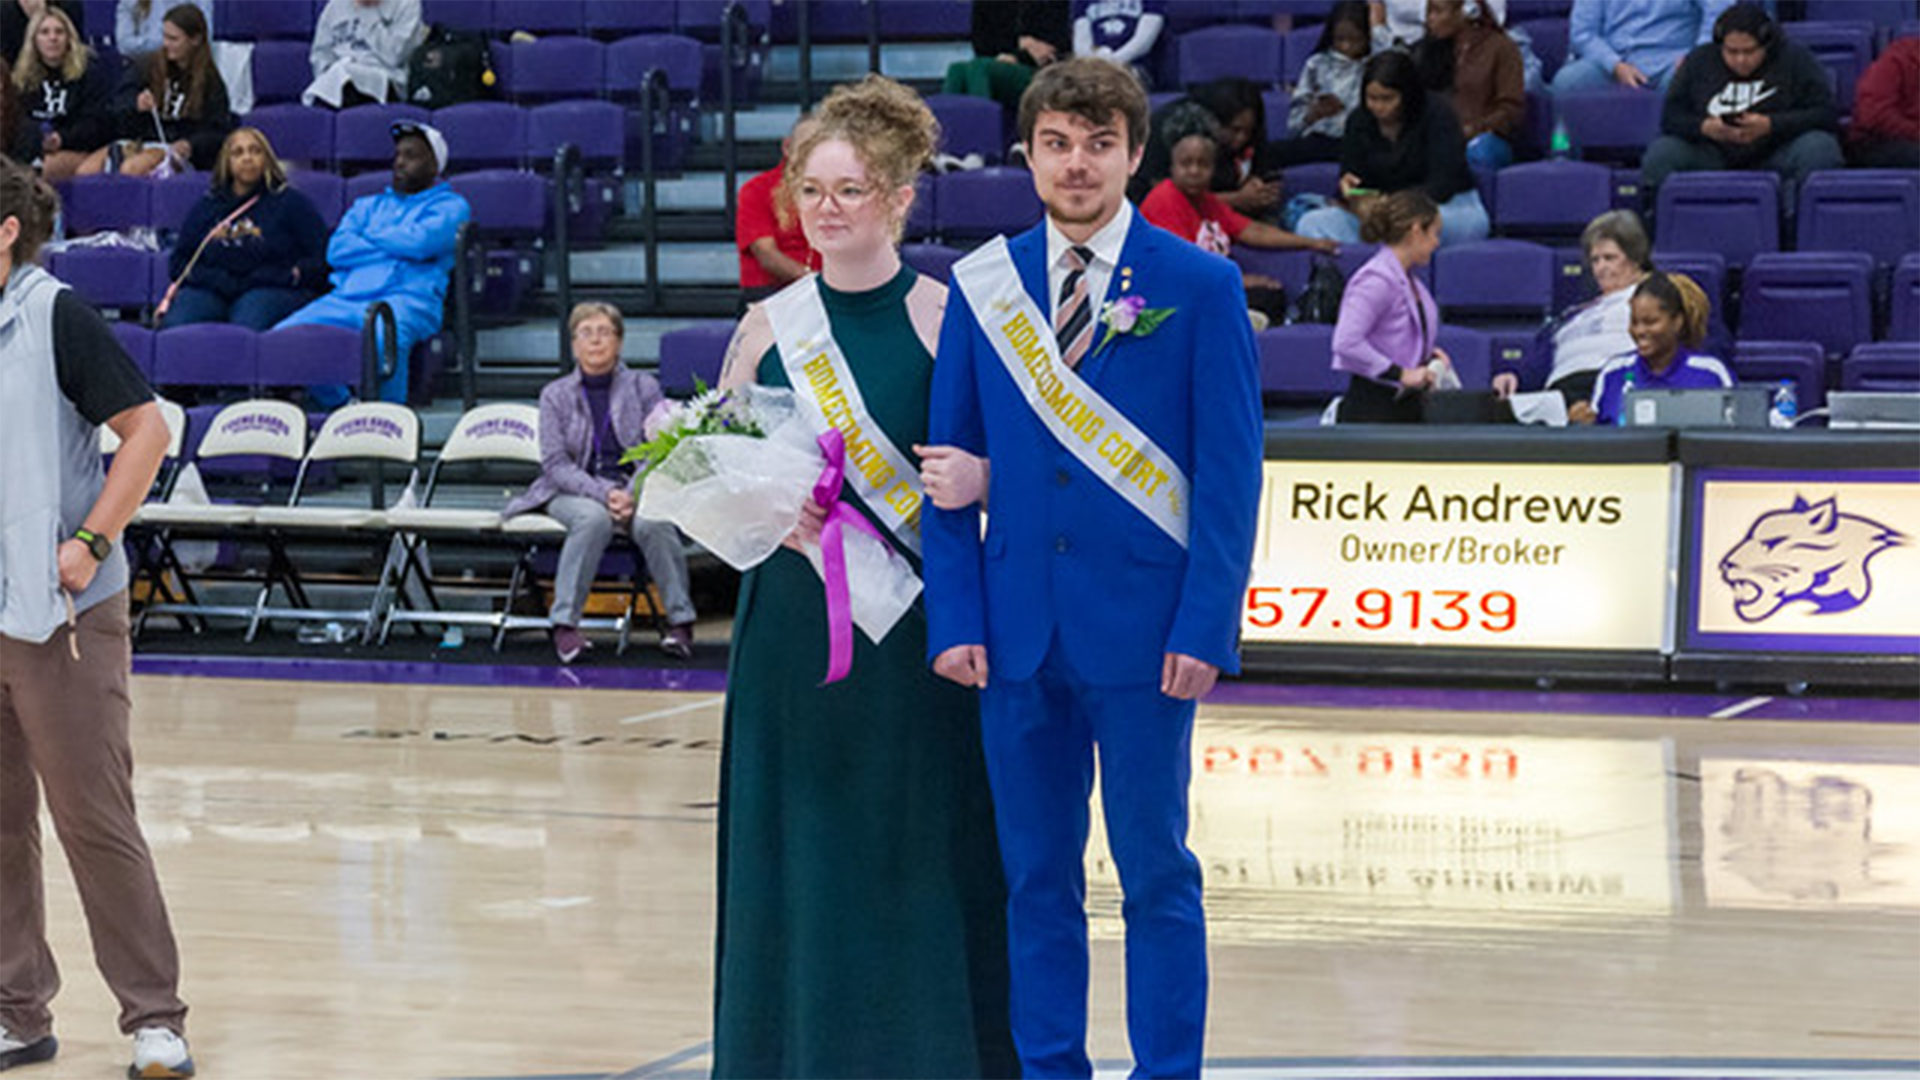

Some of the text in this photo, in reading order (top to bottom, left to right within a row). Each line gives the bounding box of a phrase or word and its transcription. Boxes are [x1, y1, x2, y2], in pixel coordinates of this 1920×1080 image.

[803, 352, 896, 490] HOMECOMING
[1002, 311, 1170, 498] HOMECOMING COURT
[1291, 482, 1623, 524] Rick Andrews
[1340, 533, 1567, 565] Owner/Broker
[1246, 587, 1518, 633] 57.9139
